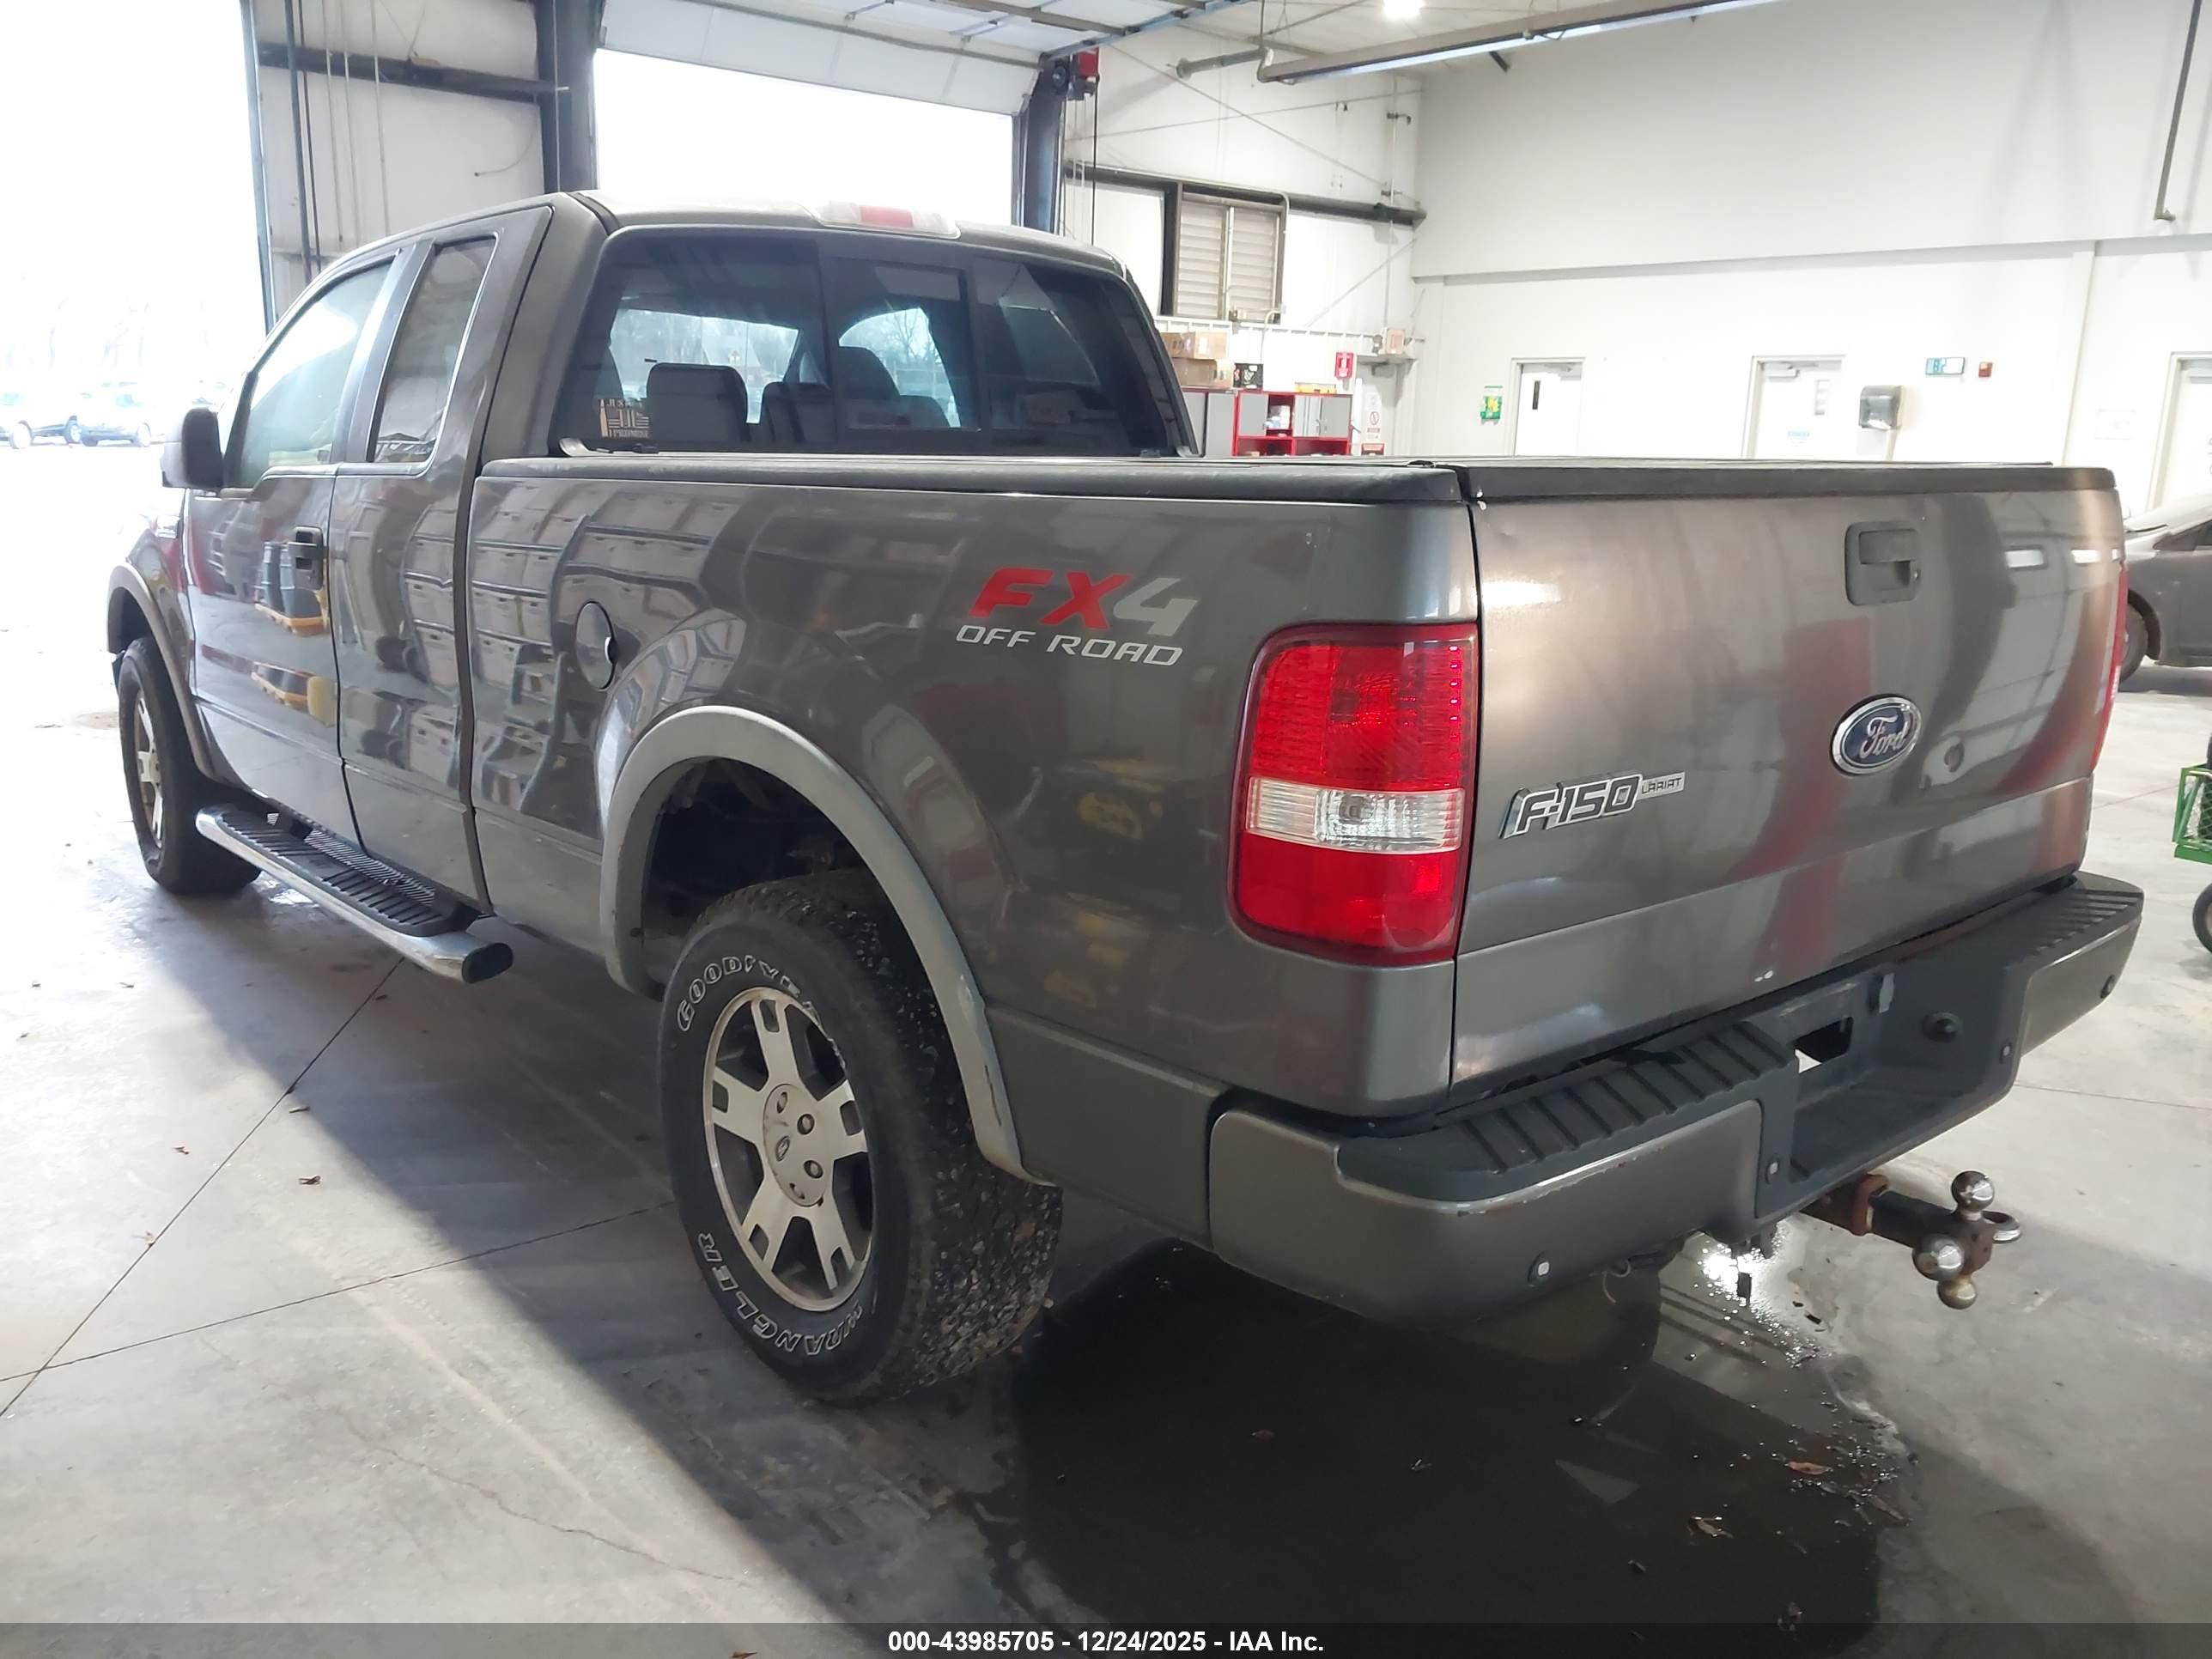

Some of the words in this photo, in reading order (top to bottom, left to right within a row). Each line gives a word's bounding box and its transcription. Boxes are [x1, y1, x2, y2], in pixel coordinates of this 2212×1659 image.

[968, 566, 1200, 637] FX4
[955, 624, 1036, 647] OFF
[1046, 634, 1183, 666] ROAD
[1859, 714, 1909, 759] Ford
[1641, 776, 1683, 795] LARIAT
